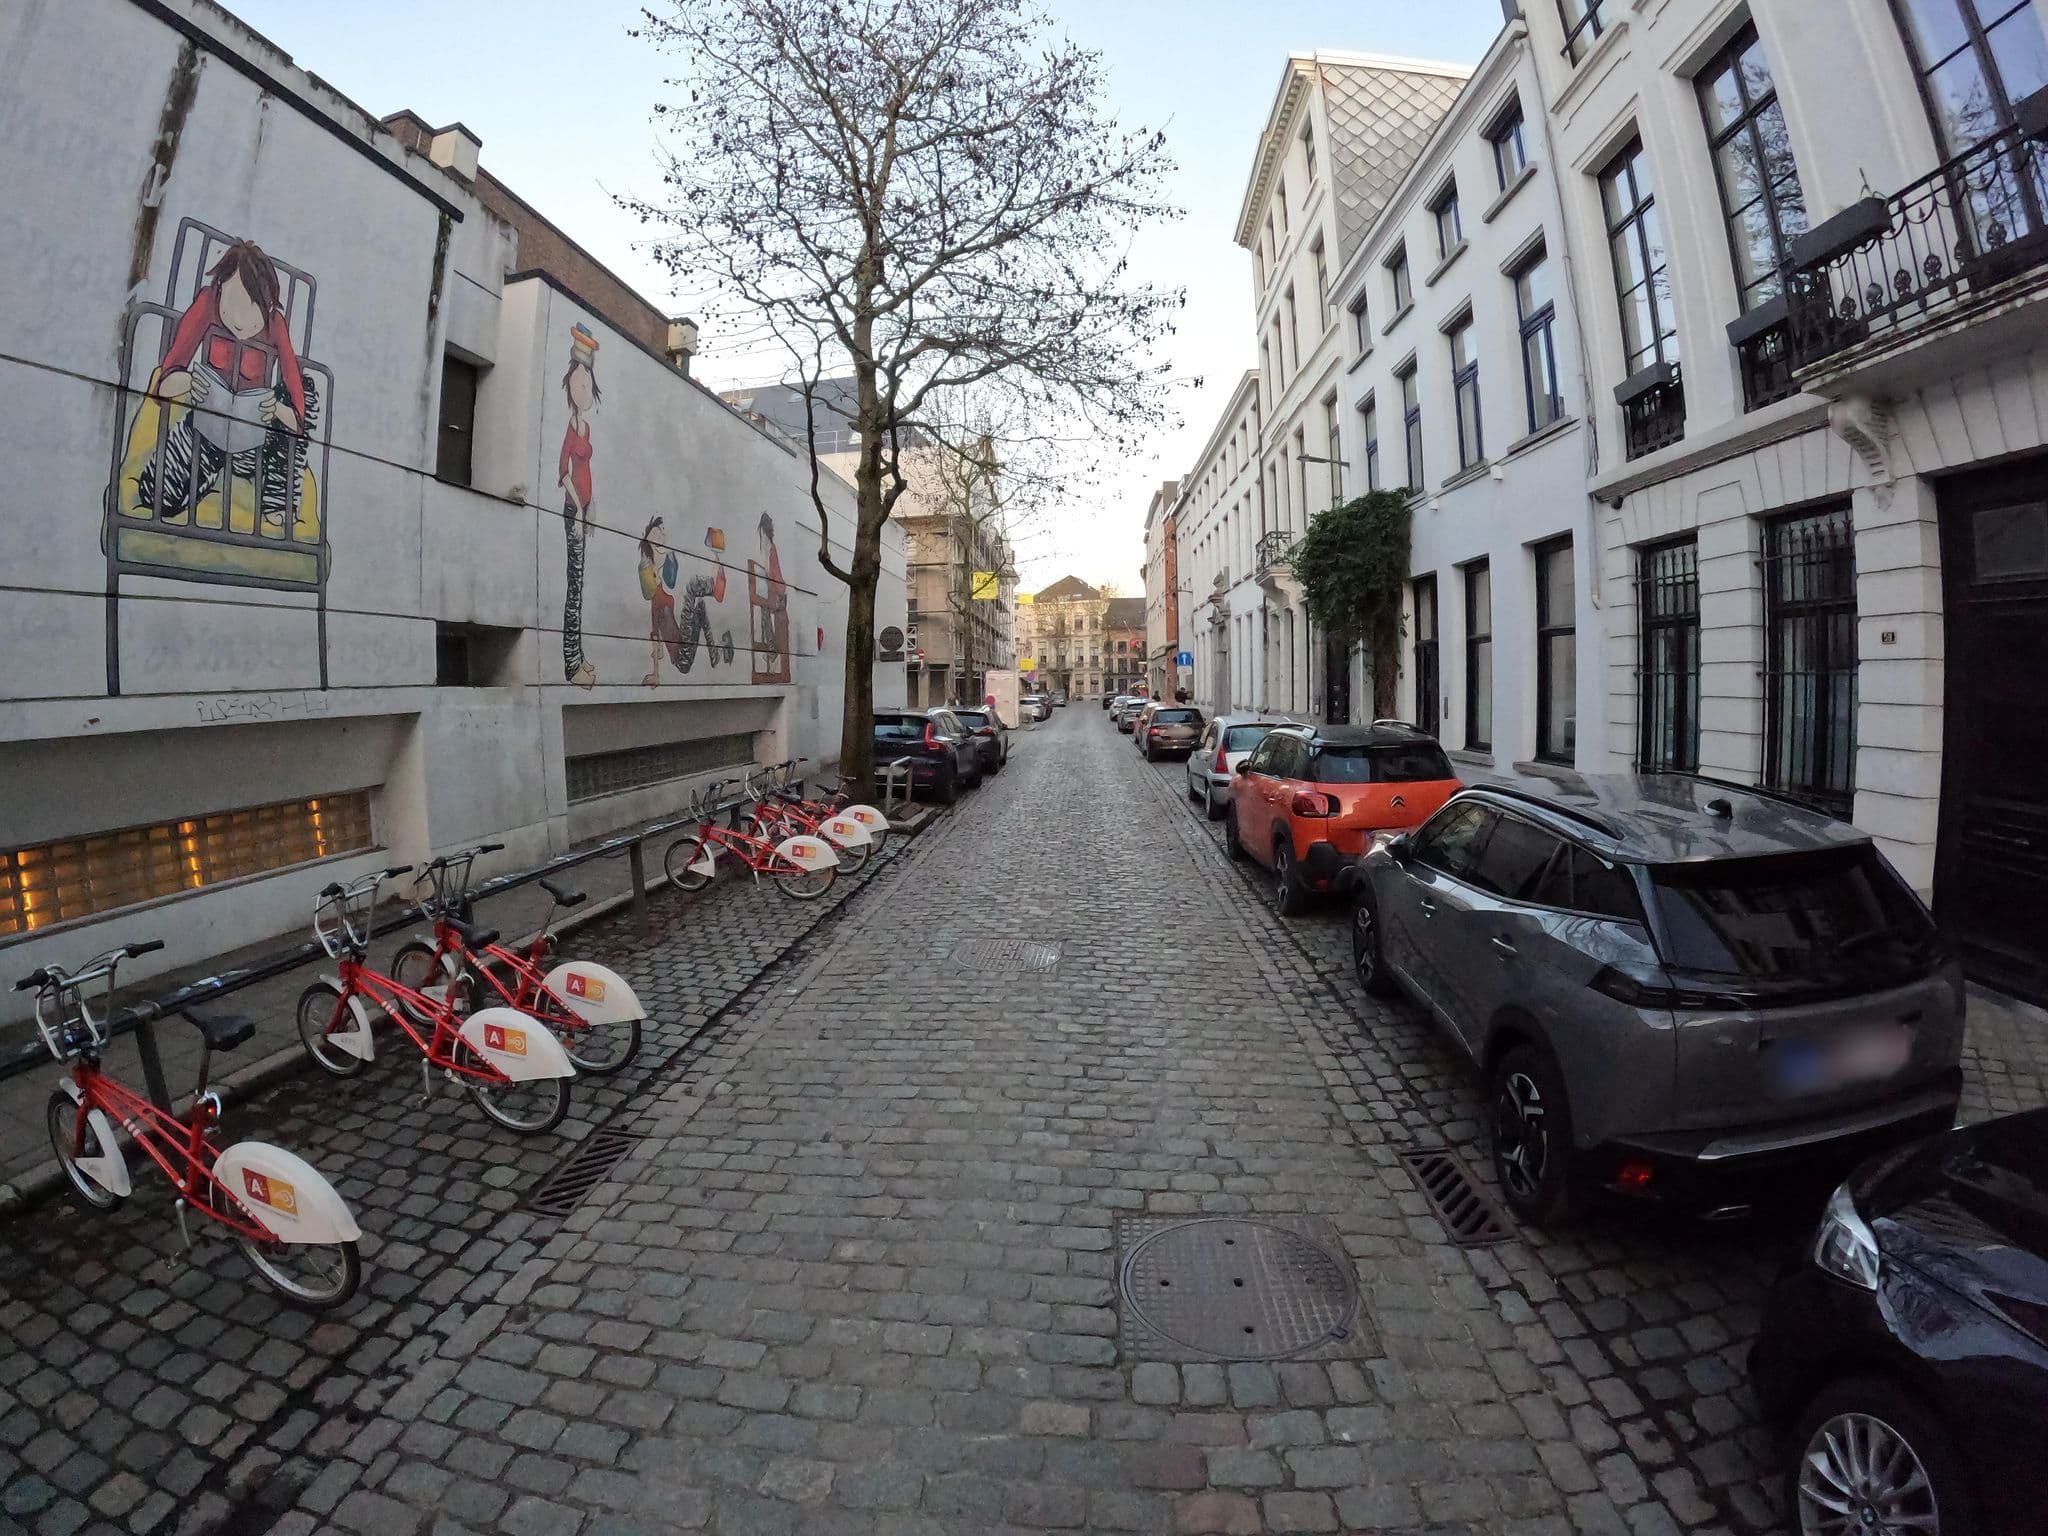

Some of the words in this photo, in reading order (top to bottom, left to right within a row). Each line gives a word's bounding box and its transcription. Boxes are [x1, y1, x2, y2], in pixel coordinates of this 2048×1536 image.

[571, 979, 580, 992] A
[489, 1030, 500, 1045] A
[251, 1178, 265, 1197] A
